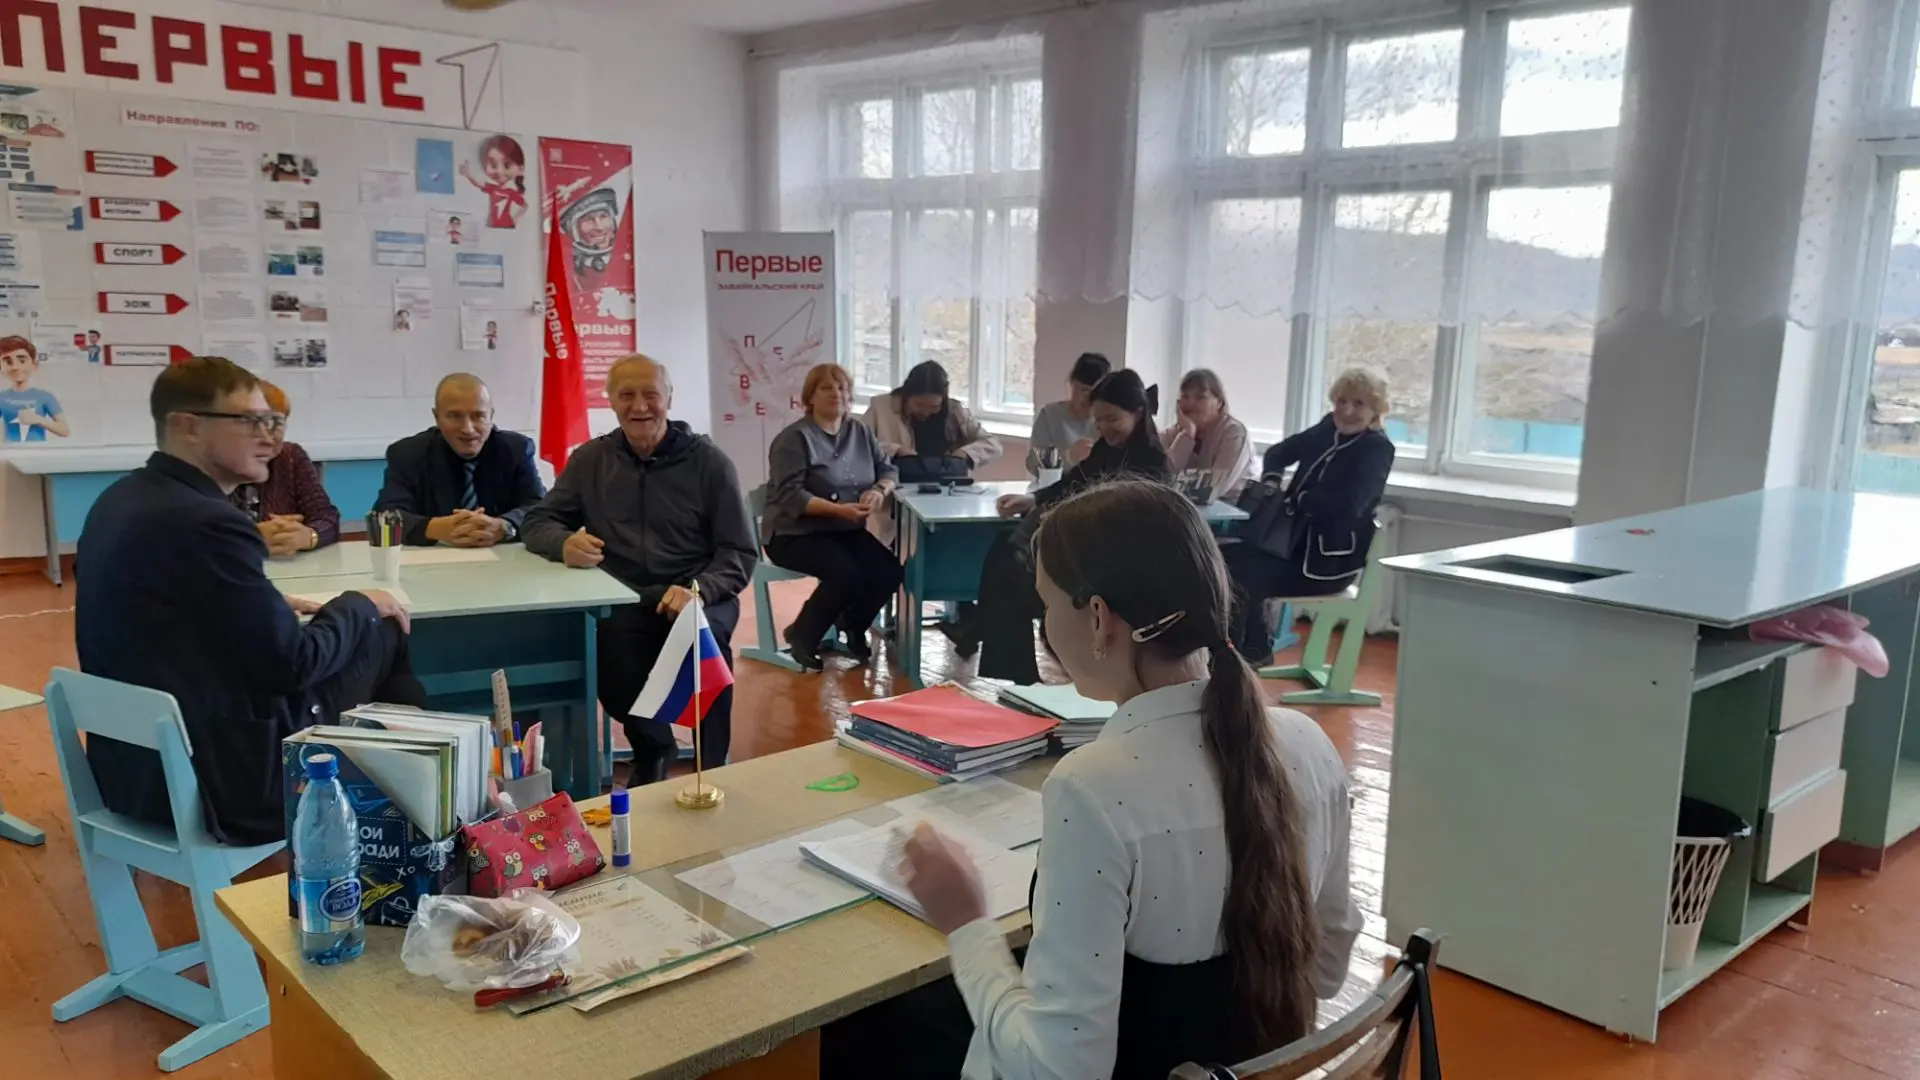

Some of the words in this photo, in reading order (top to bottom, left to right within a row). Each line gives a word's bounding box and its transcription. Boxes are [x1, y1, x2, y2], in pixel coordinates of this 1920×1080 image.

[0, 0, 425, 112] ПЕРВЫЕ
[126, 110, 228, 129] Направления
[113, 247, 154, 258] СПОРТ
[716, 249, 822, 280] Первые
[123, 300, 152, 309] ЗОЖ
[360, 825, 383, 841] ои
